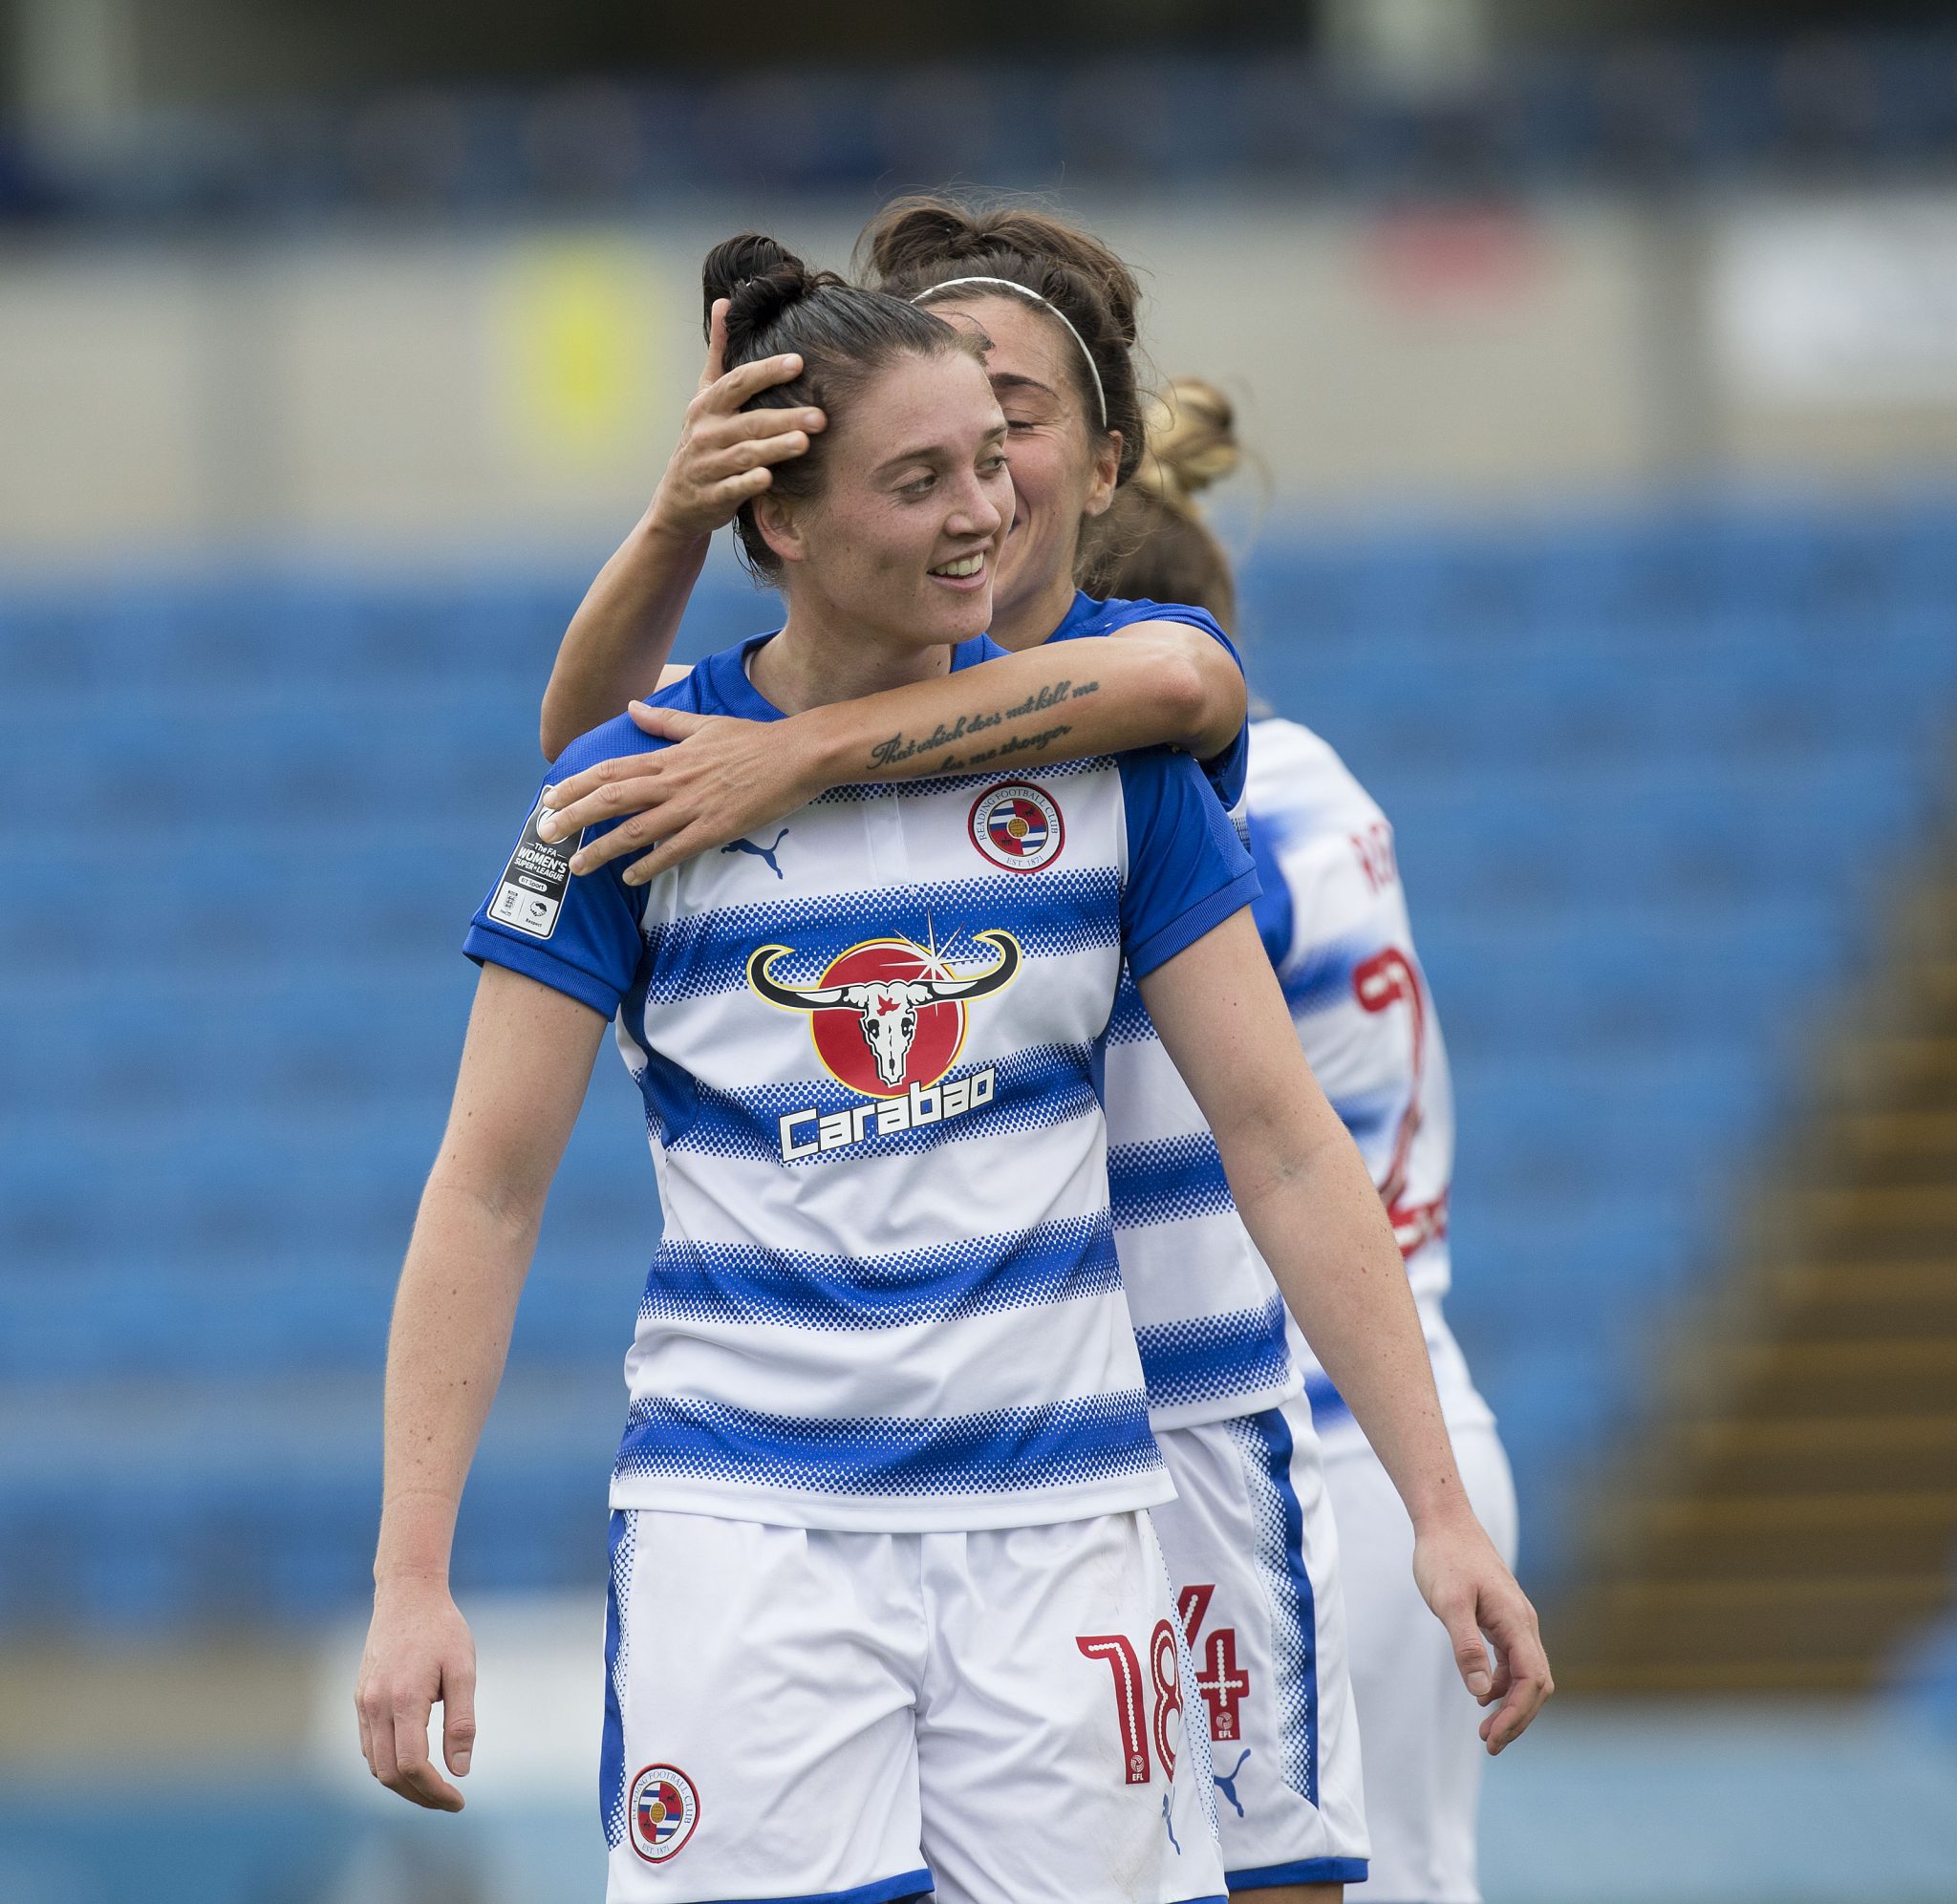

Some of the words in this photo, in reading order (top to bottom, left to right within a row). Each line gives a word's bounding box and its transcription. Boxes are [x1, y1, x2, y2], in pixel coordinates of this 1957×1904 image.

[867, 732, 914, 769] That
[917, 717, 964, 753] which
[966, 714, 1001, 734] does
[1005, 696, 1034, 718] not
[1034, 680, 1071, 711] kill
[1072, 681, 1099, 698] me
[969, 748, 997, 764] me
[1000, 726, 1072, 755] stronger
[977, 798, 996, 841] READING
[996, 788, 1045, 807] FOOTBALL
[1044, 806, 1059, 834] CLUB
[517, 846, 568, 873] WOMEN'S
[534, 843, 548, 854] The
[548, 846, 557, 857] FA
[1027, 855, 1044, 866] 1871
[528, 879, 545, 890] Sport
[779, 1064, 996, 1163] Carabao
[1076, 1618, 1183, 1785] 18
[1218, 1730, 1233, 1739] EFL
[1131, 1772, 1144, 1782] EFL
[649, 1770, 688, 1795] FOOTBALL
[684, 1795, 694, 1825] CLUB
[656, 1845, 670, 1855] 1871
